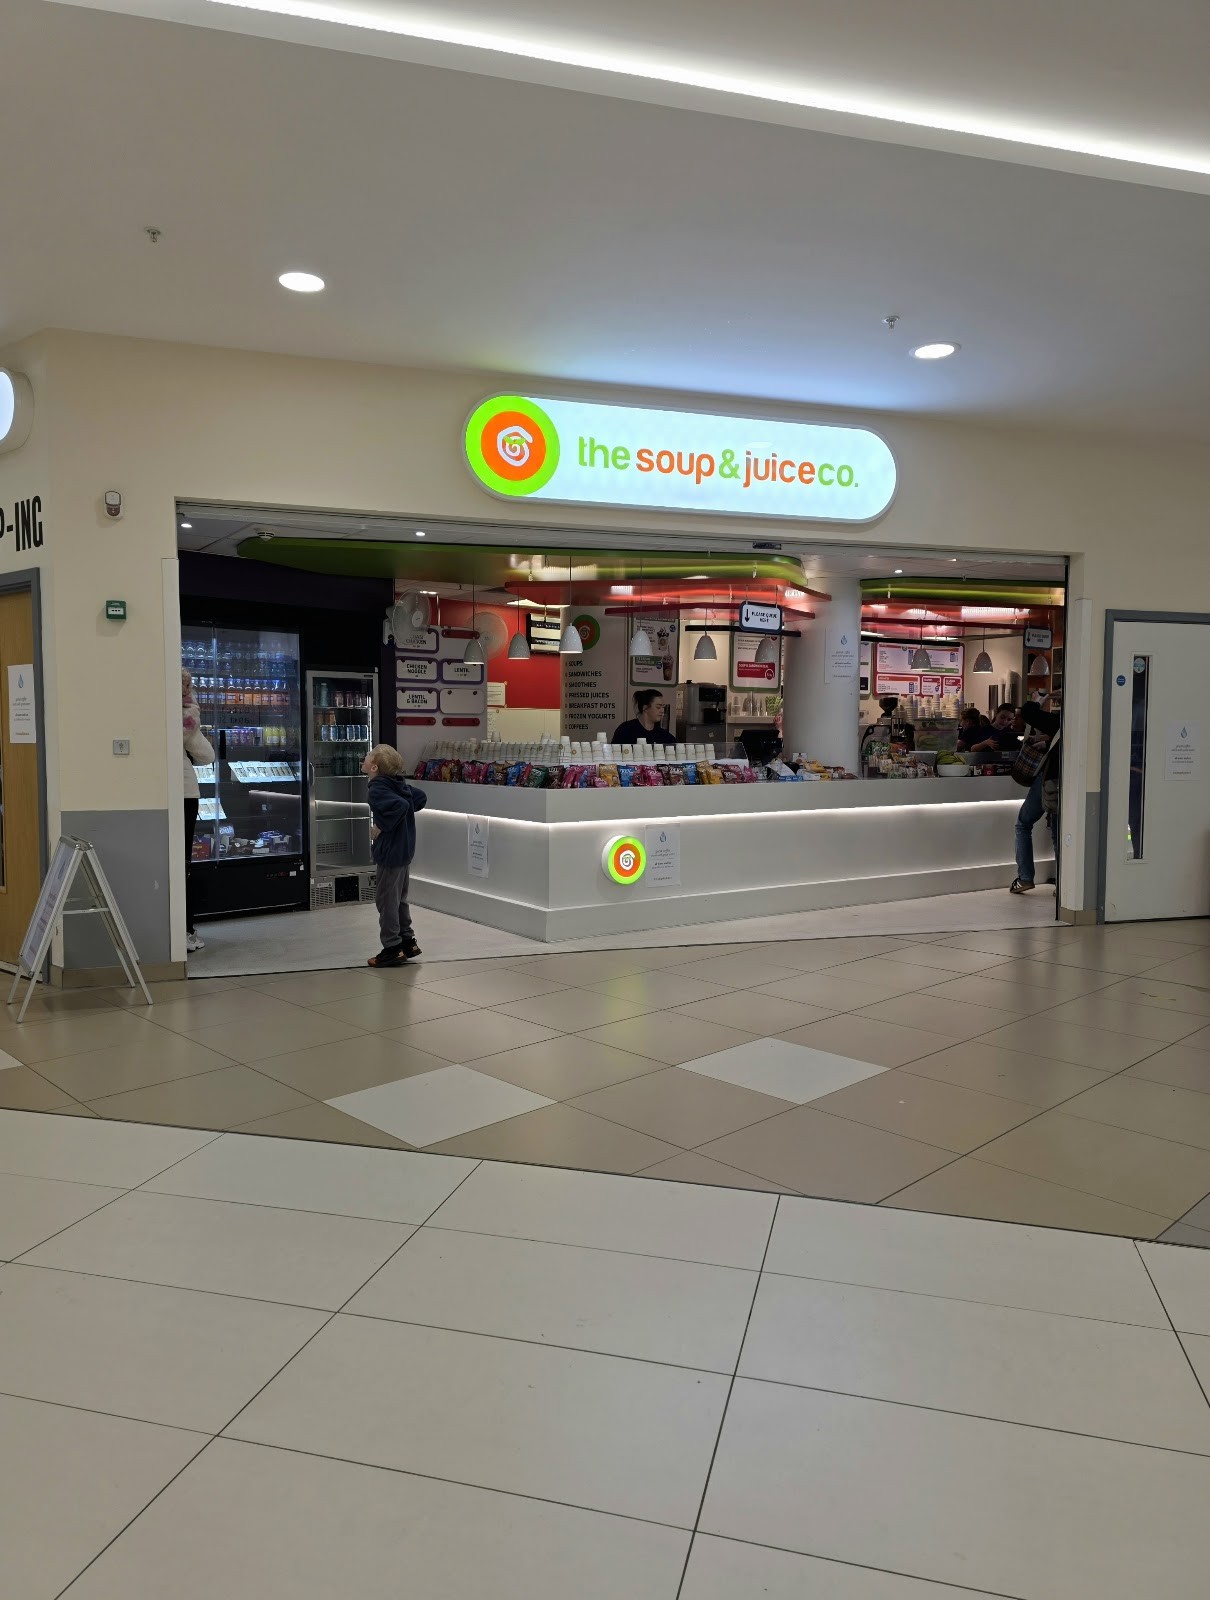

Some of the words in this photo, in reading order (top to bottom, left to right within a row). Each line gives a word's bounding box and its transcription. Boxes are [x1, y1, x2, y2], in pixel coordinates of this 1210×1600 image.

[578, 435, 630, 470] the
[635, 448, 715, 485] soup
[718, 449, 741, 479] &
[742, 450, 816, 488] juice
[818, 462, 860, 488] co.
[568, 670, 602, 678] SANDWICHES
